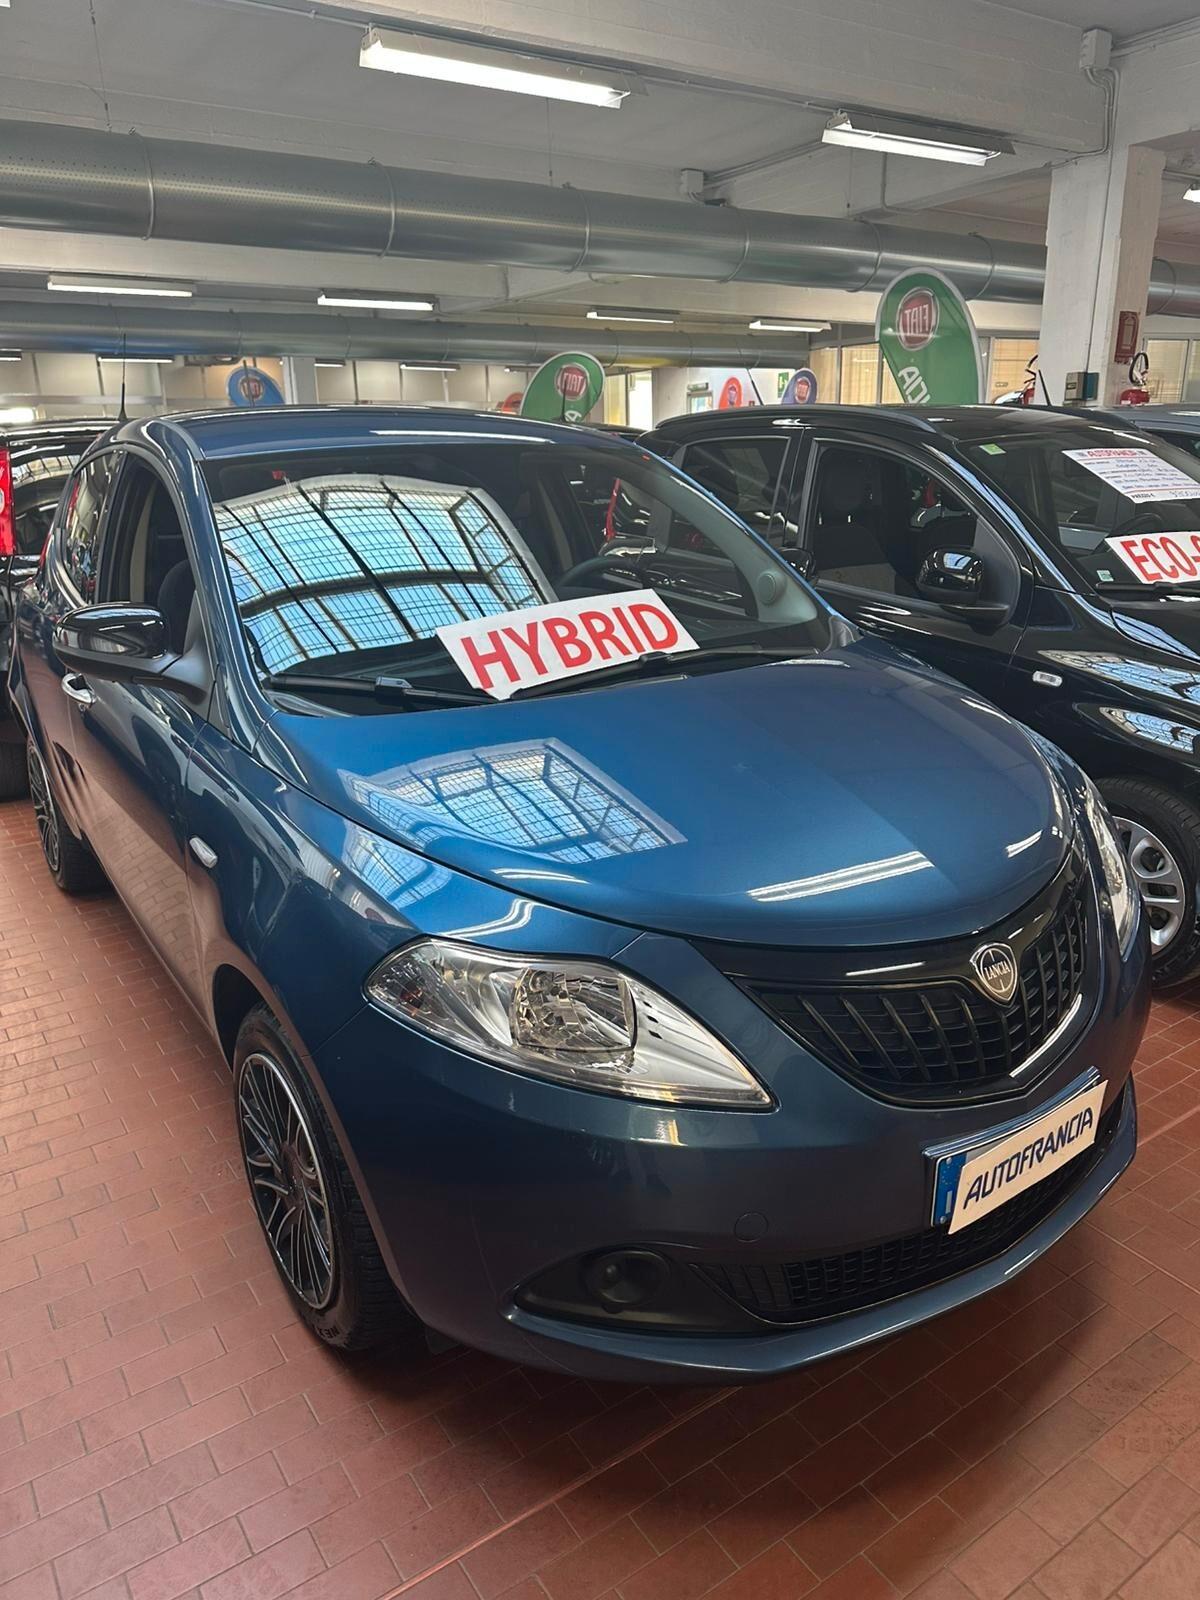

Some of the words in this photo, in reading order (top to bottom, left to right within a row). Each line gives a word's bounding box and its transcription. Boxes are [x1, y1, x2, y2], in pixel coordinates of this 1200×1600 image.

[562, 372, 584, 393] FIAT
[461, 603, 678, 690] HYBRID
[984, 960, 1011, 981] LANCIA
[963, 1107, 1093, 1210] AUTOFRANCIA
